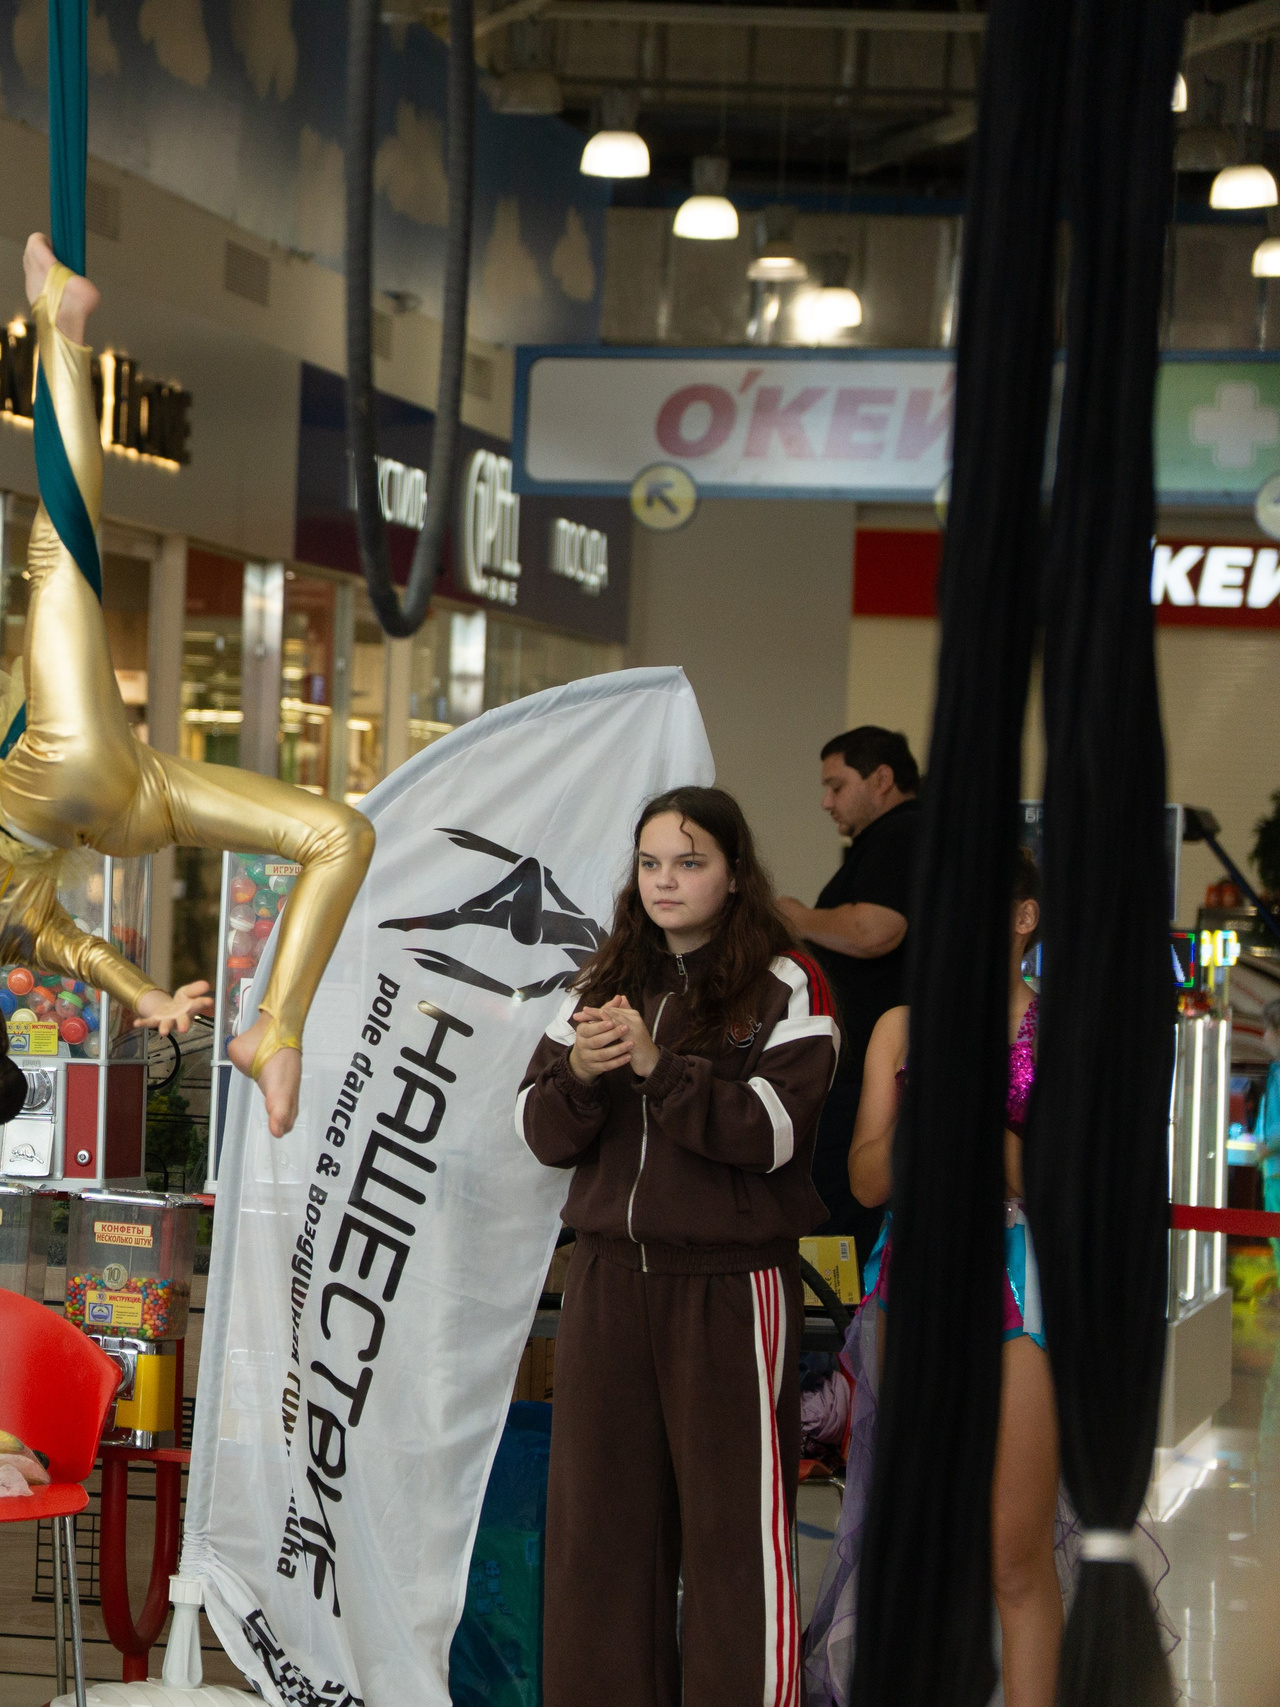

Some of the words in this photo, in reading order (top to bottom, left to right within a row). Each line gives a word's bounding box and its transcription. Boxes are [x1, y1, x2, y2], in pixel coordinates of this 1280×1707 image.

[361, 972, 402, 1047] pole
[325, 1051, 374, 1148] dance
[315, 1152, 341, 1178] &
[95, 1233, 133, 1245] НЕСКОЛЬКО
[134, 1236, 152, 1247] ШТУК
[101, 1223, 144, 1235] КОНФЕТЫ
[105, 1266, 122, 1282] 10
[299, 1000, 474, 1618] НАШЕСТВИЕ
